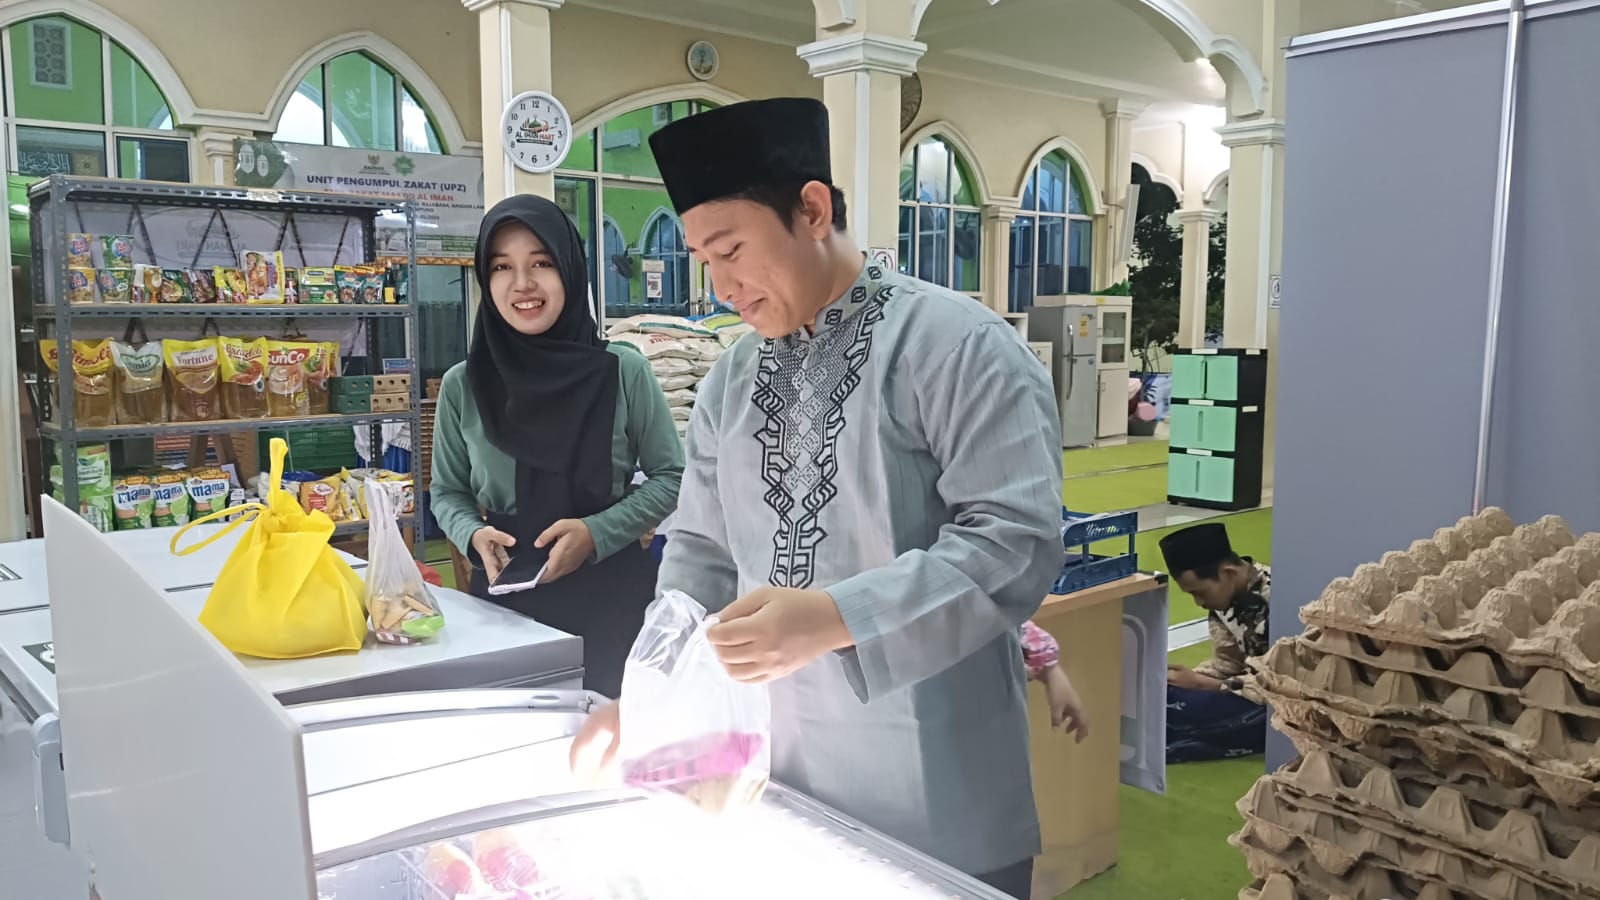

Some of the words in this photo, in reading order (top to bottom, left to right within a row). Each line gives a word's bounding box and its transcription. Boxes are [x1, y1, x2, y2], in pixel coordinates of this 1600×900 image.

[520, 103, 526, 111] 11
[532, 100, 540, 109] 12
[511, 113, 518, 121] 10
[507, 126, 513, 134] 9
[531, 155, 538, 163] 6
[306, 175, 334, 184] UNIT
[336, 177, 401, 188] PENGUMPUL
[403, 180, 437, 190] ZAKAT
[440, 182, 467, 193] (UPZ)
[176, 353, 214, 366] Fortune
[192, 482, 225, 497] mama
